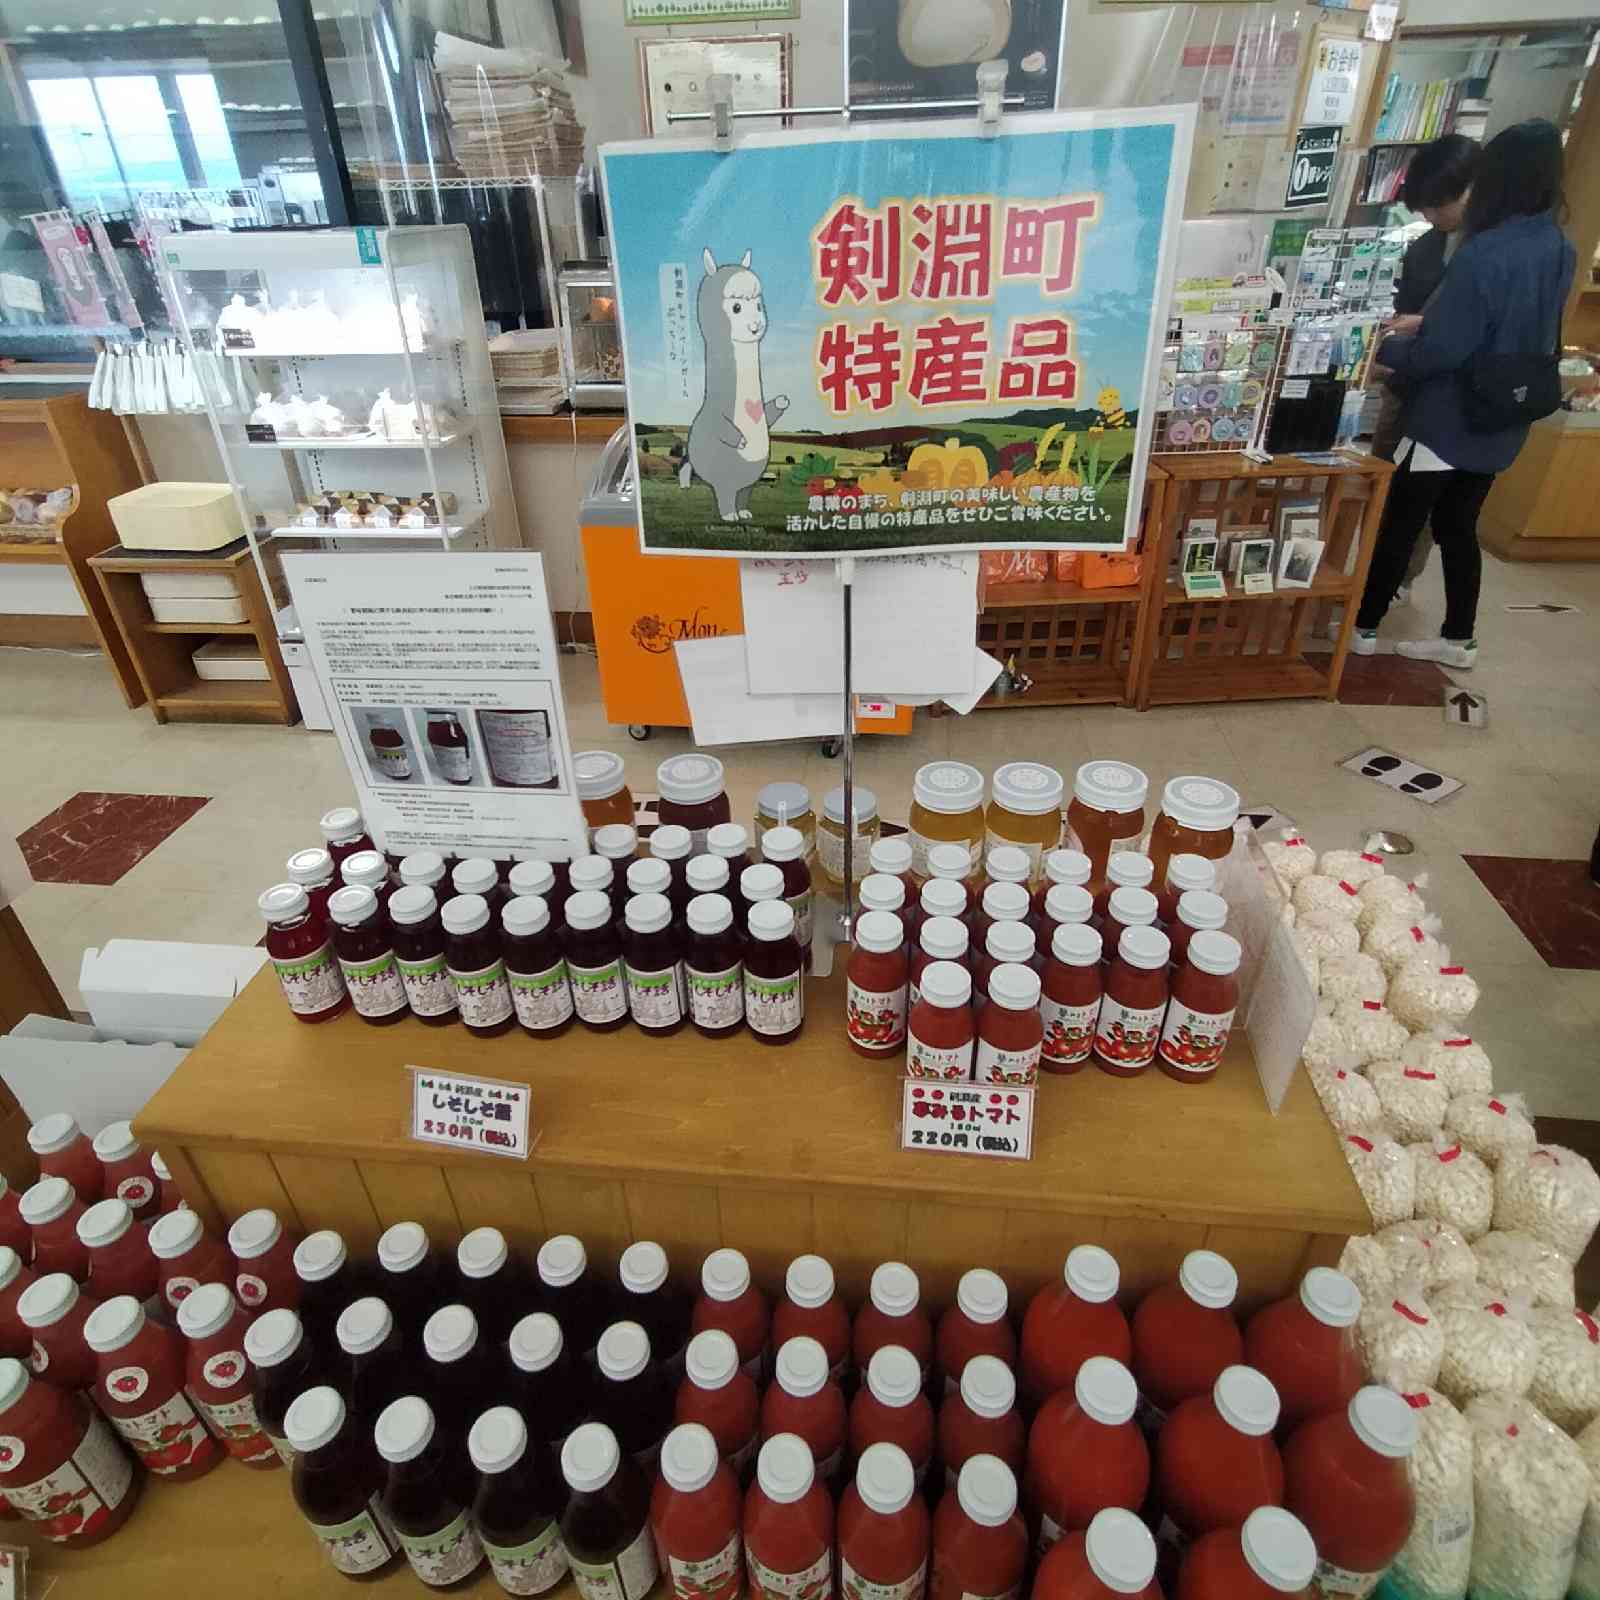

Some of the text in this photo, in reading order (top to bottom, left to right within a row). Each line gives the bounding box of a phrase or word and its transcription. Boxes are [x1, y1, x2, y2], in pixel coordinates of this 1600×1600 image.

[818, 200, 1095, 304] 剣淵町
[819, 317, 1076, 411] 特産品
[786, 505, 1112, 532] 活かした自慢の特産品をぜひご賞味ください。
[808, 486, 1096, 513] 農業のまち、剣淵町の美味しい農産物を
